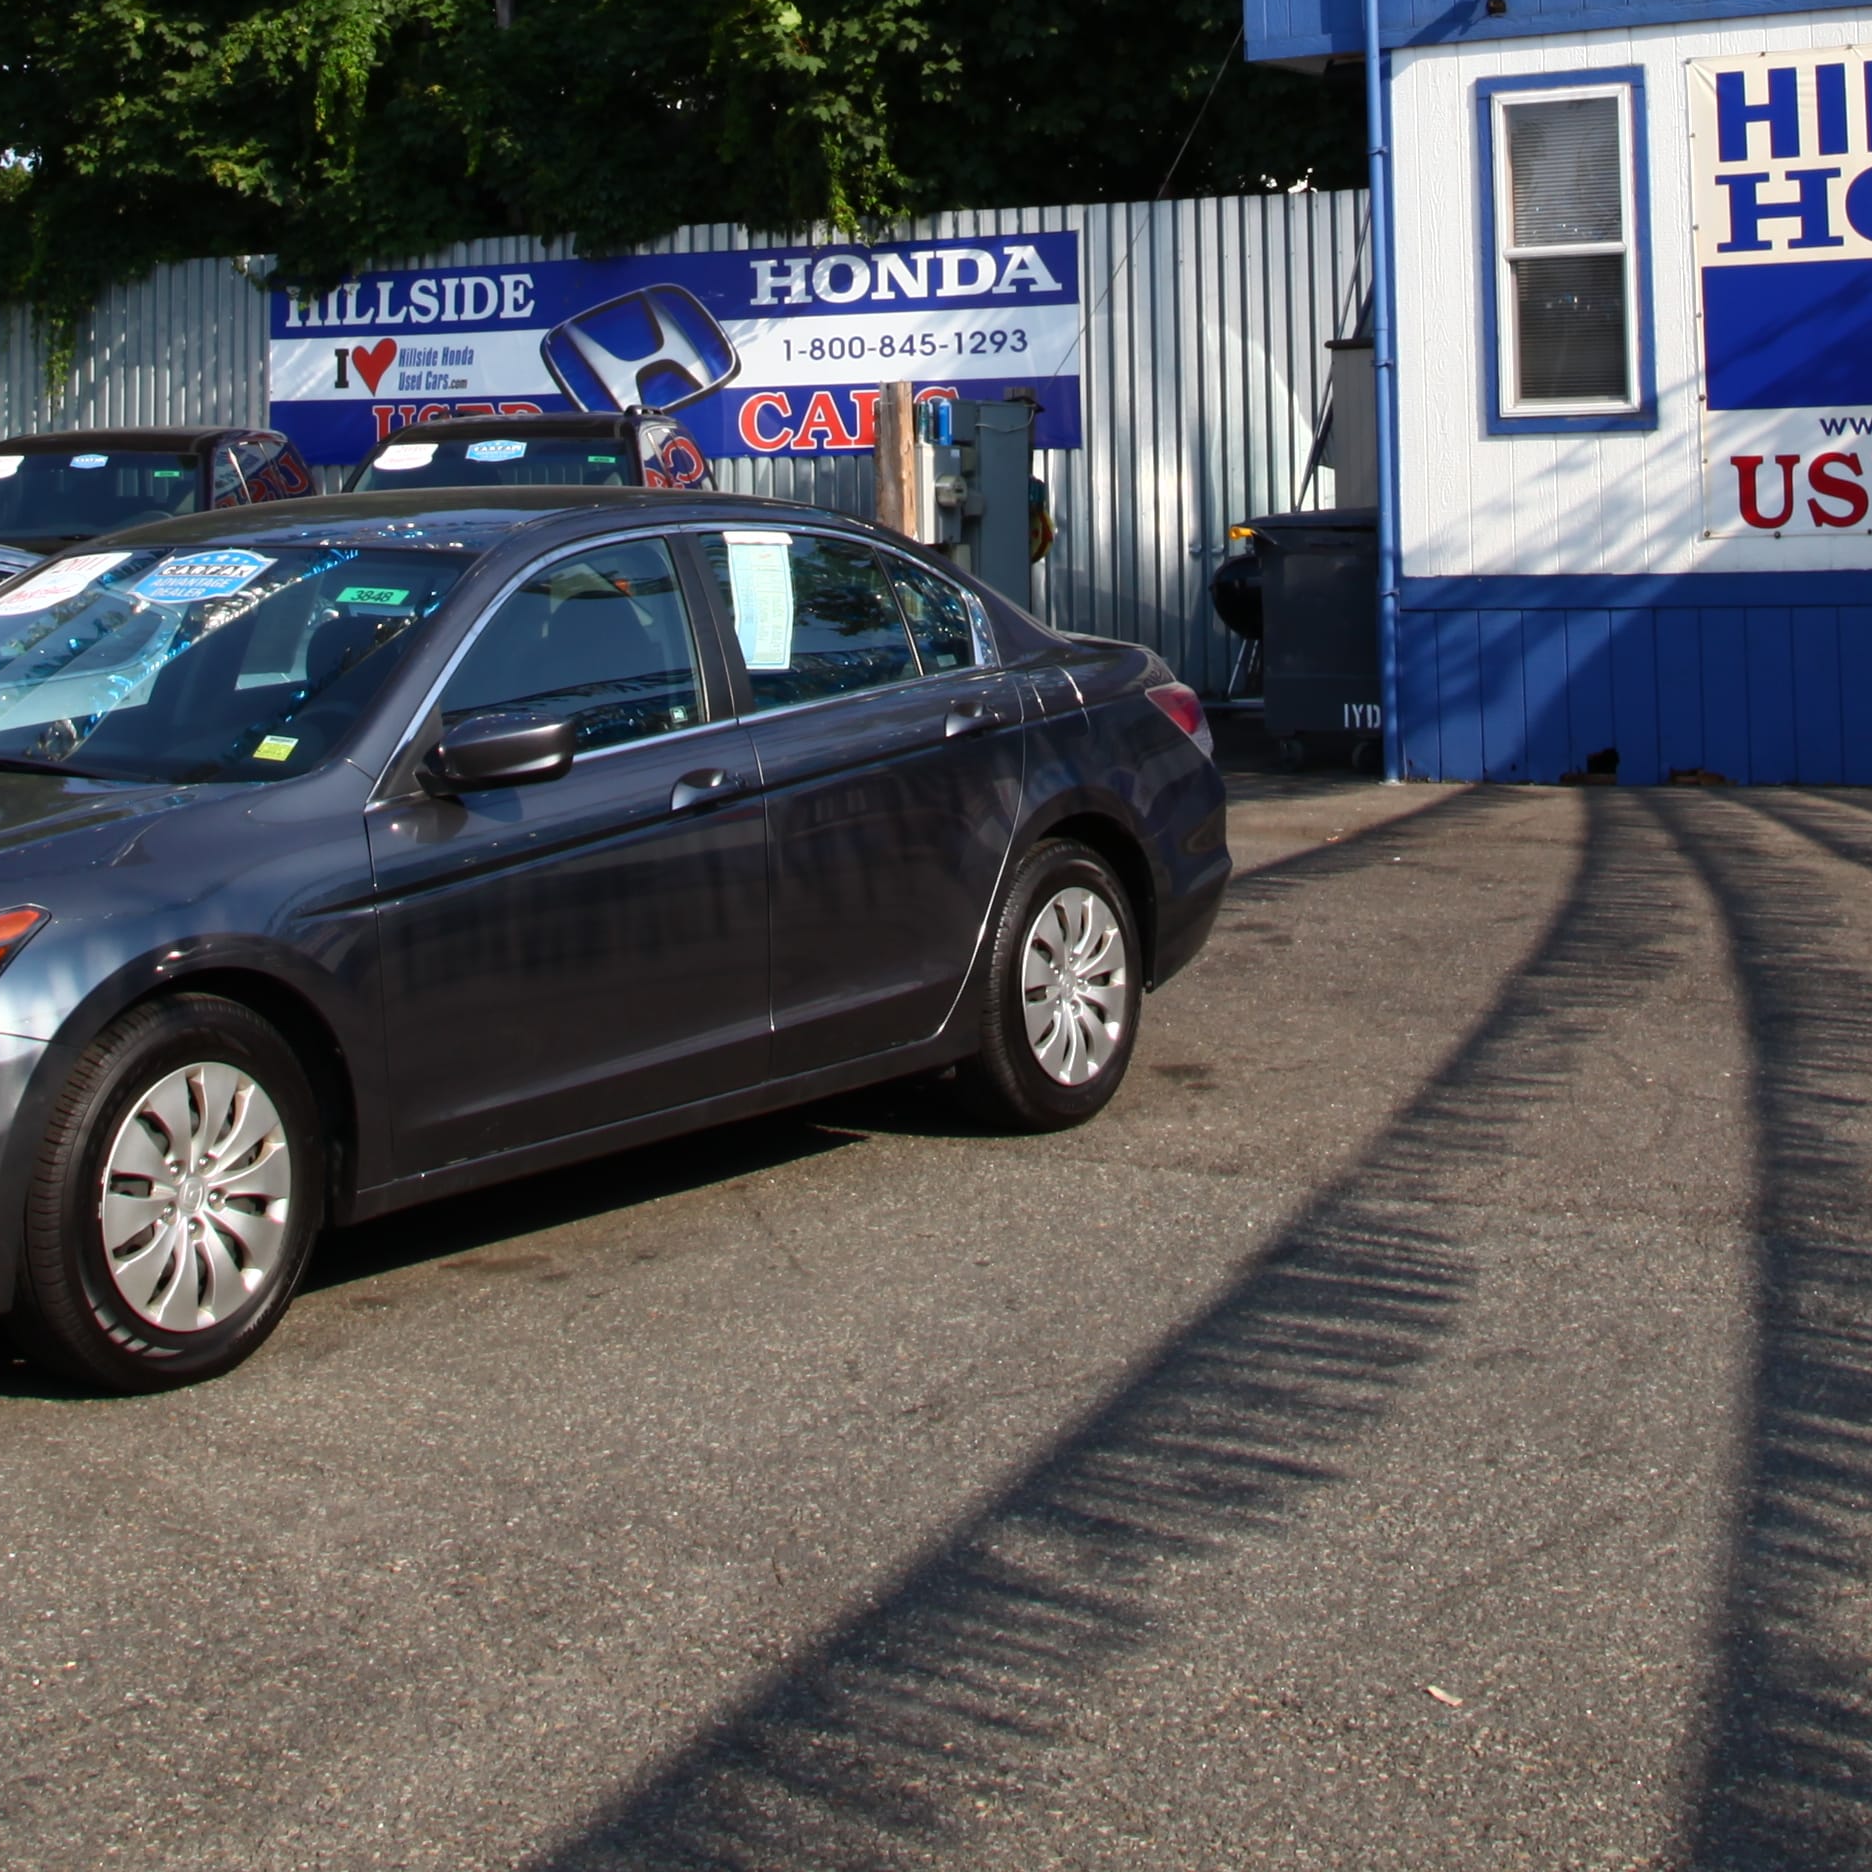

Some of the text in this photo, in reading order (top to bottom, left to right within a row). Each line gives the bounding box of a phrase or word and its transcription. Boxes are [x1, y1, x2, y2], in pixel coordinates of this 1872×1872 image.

[750, 245, 1062, 306] HONDA
[783, 329, 1028, 362] 1-800-845-1293
[334, 346, 474, 388] I Hillside Honda
[398, 371, 422, 391] Used
[161, 565, 259, 577] CARFAX
[350, 590, 394, 602] 3848
